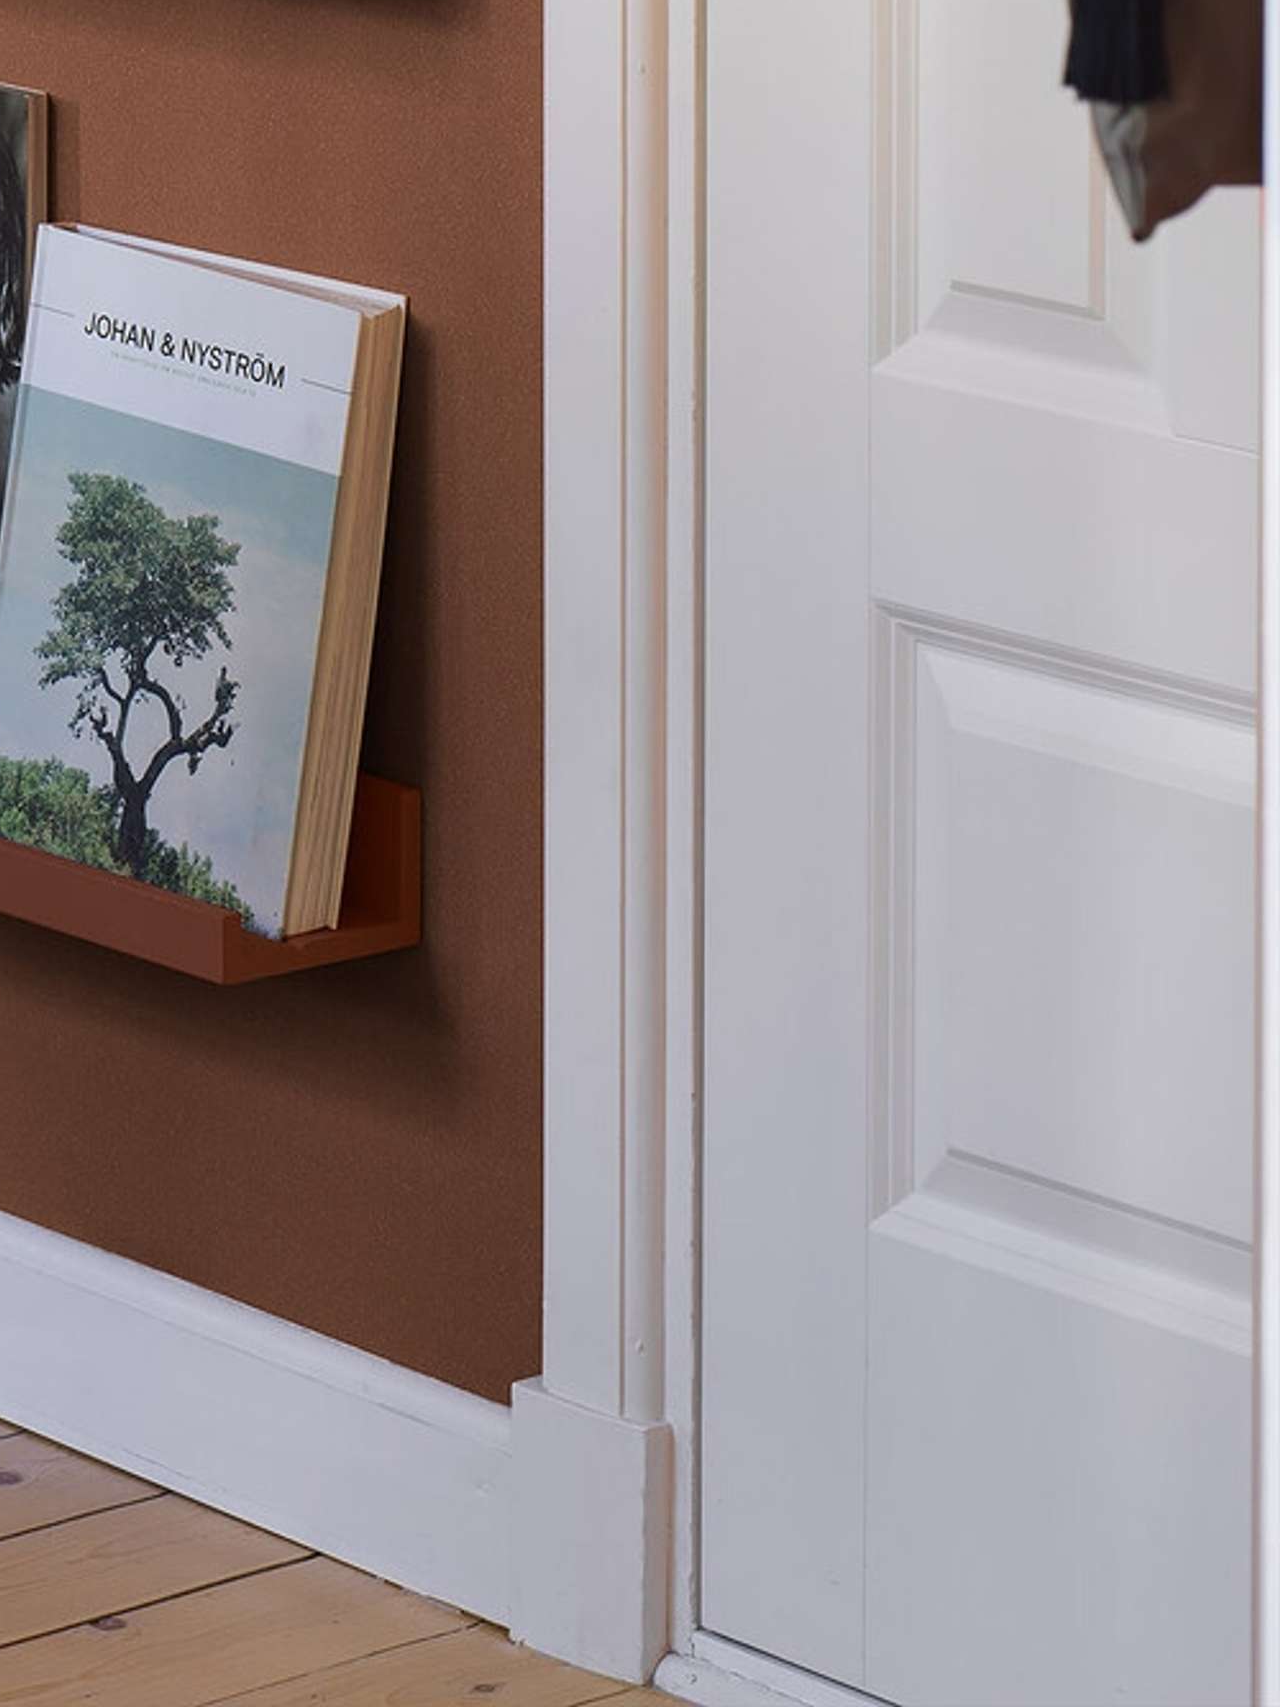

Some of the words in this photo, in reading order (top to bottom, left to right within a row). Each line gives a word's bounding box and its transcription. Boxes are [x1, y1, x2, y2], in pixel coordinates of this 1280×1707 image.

[84, 313, 155, 352] JOHAN
[160, 333, 176, 356] &
[180, 338, 286, 388] NYSTRÖM
